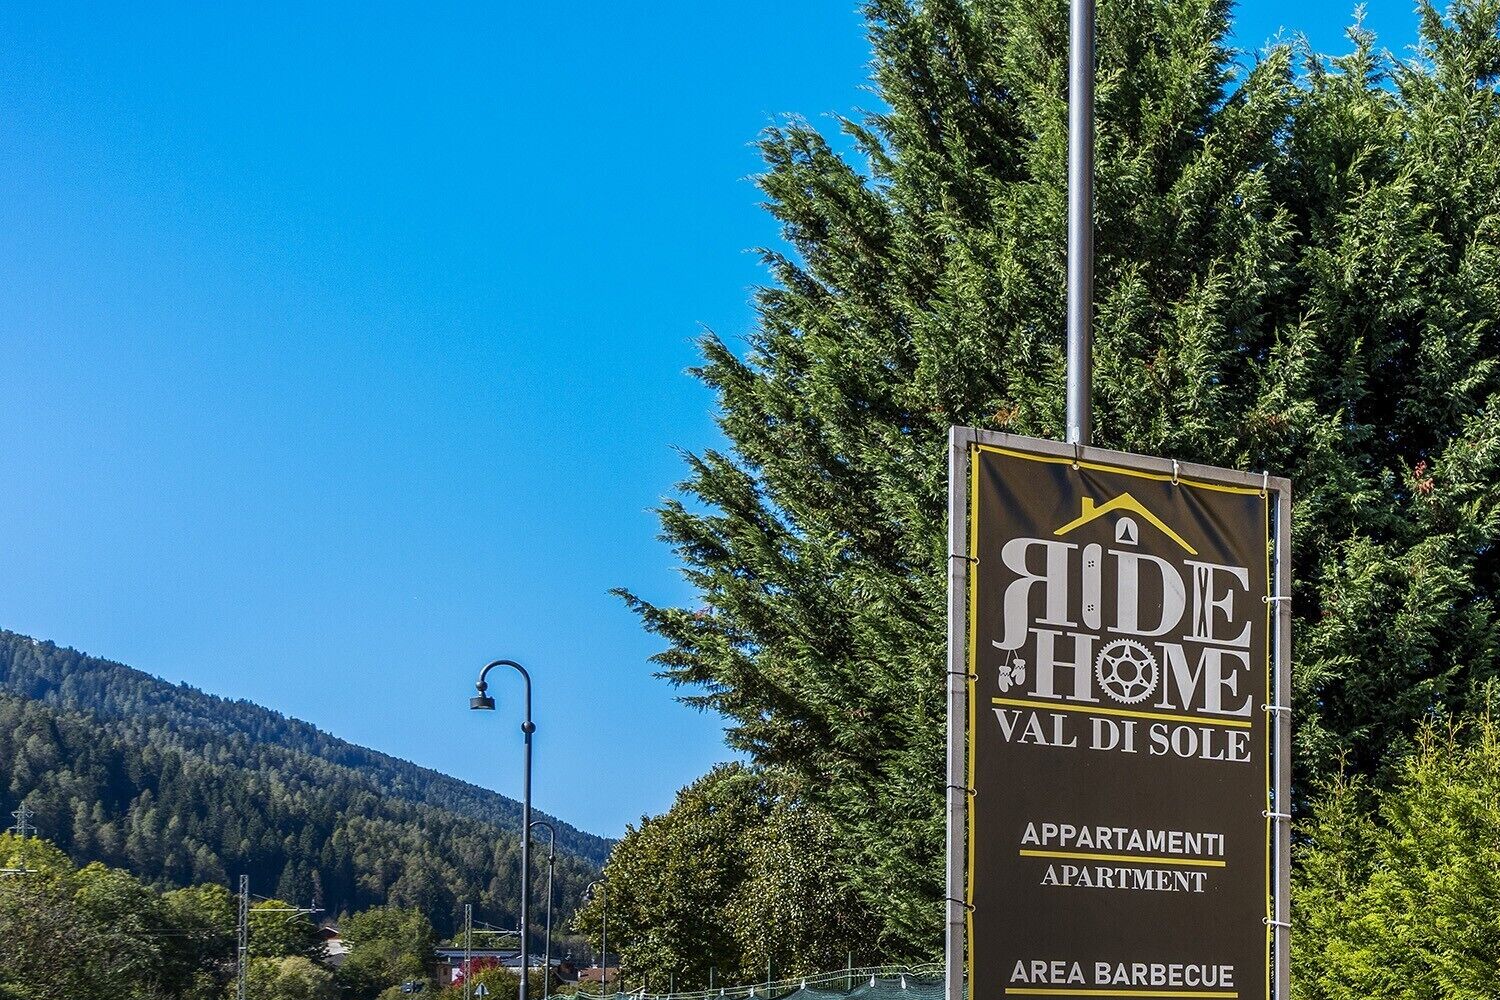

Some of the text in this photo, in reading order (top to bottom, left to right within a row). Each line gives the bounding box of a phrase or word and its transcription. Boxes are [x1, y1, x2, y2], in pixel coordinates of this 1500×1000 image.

[992, 708, 1251, 763] VAL DI SOLE
[1020, 822, 1225, 856] APPARTAMENTI
[1040, 864, 1207, 893] APARTMENT
[1009, 960, 1234, 988] AREA BARBECUE
